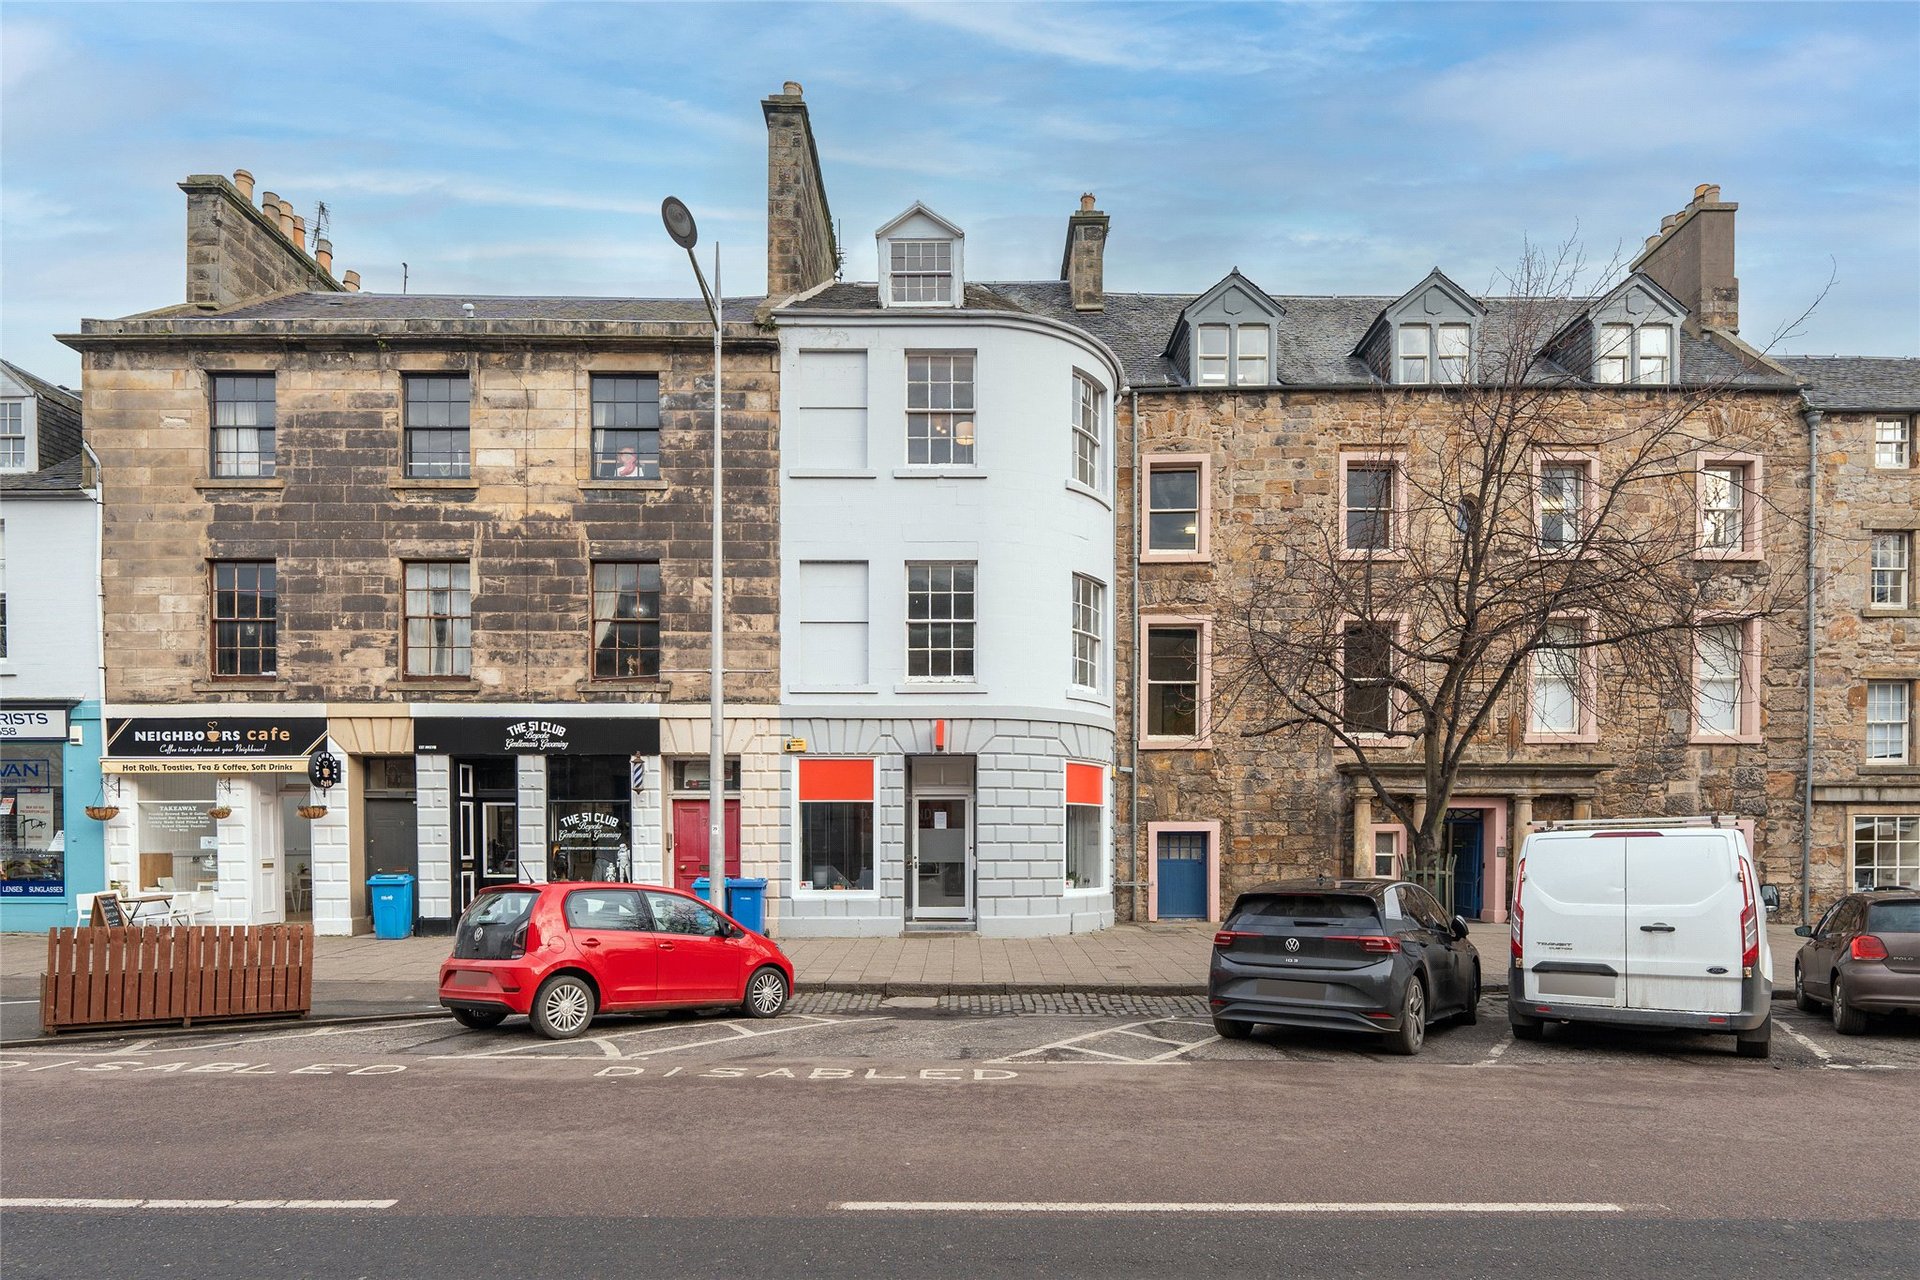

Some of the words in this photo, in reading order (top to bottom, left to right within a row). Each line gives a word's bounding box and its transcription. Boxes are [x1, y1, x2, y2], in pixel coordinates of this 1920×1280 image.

[0, 727, 17, 736] 58
[247, 726, 290, 741] cafe
[507, 722, 527, 736] THE
[528, 721, 539, 731] 51
[541, 721, 567, 737] CLUB
[524, 730, 550, 741] Bespoke
[160, 744, 177, 754] Coffee
[190, 744, 203, 754] right
[539, 738, 569, 750] Grooming
[139, 764, 160, 772] Rolls,
[222, 763, 249, 771] Coffee,
[251, 763, 266, 771] Soft
[269, 763, 293, 771] Drinks
[560, 813, 580, 827] THE
[581, 812, 592, 822] 51
[594, 812, 619, 827] CLUB
[577, 821, 603, 832] Bespoke
[592, 829, 621, 841] Grooming
[593, 1066, 1019, 1080] DISABLED
